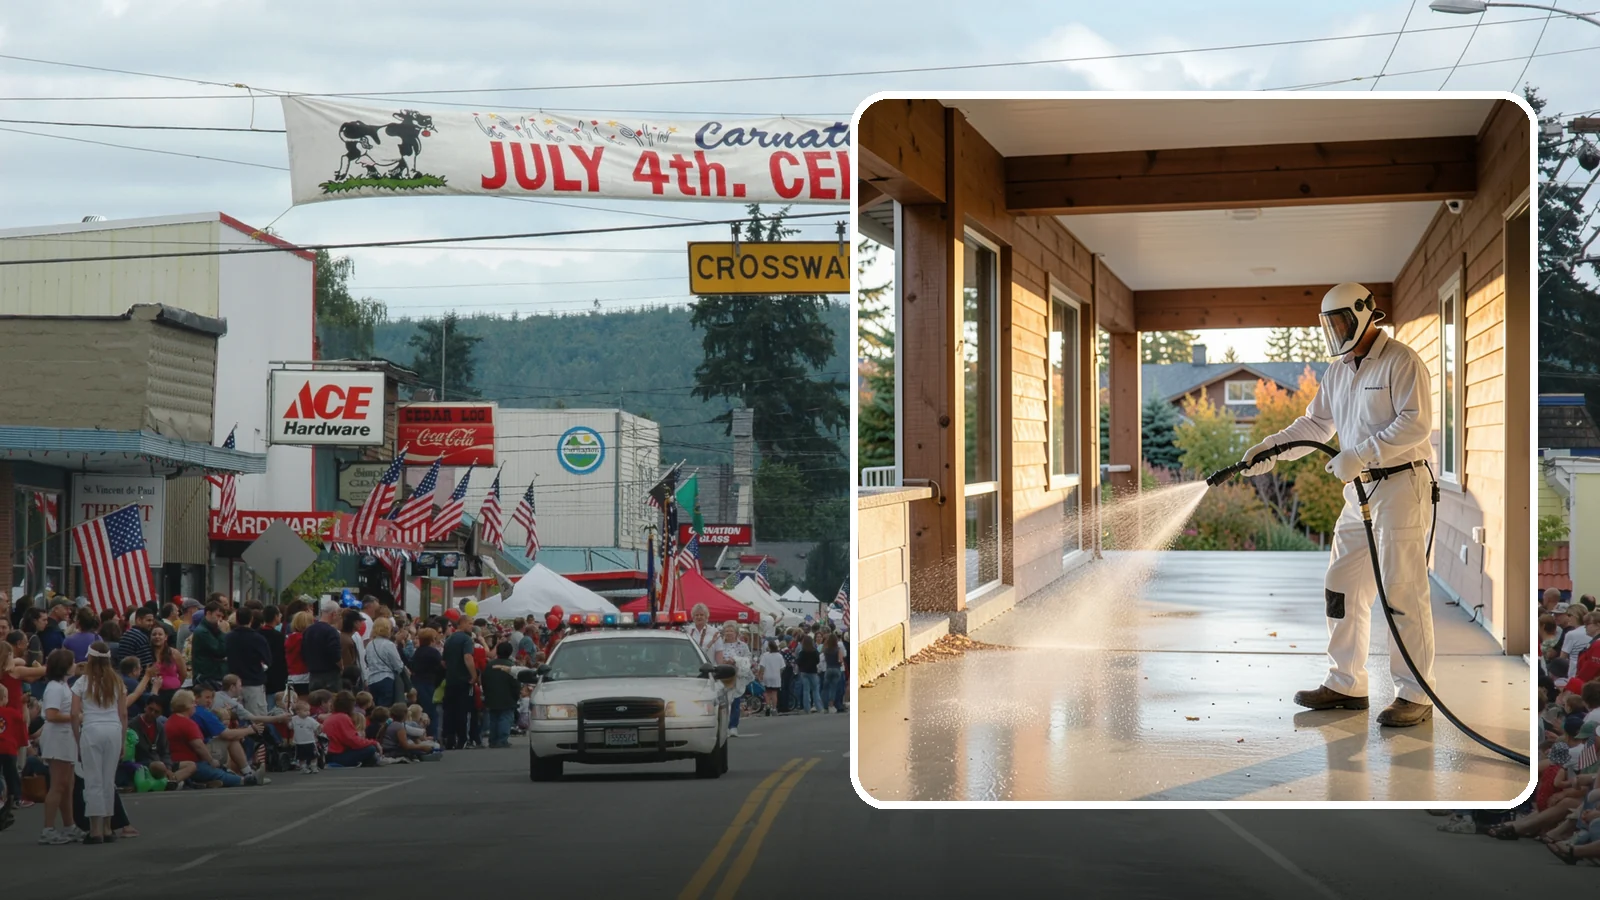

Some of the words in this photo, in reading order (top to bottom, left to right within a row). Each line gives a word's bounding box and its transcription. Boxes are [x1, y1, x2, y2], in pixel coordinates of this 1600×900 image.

[481, 141, 604, 192] JULY
[632, 149, 746, 198] 4th.
[697, 254, 850, 280] CROSSWA
[283, 380, 373, 420] ACE
[405, 409, 452, 422] CEDAR
[283, 421, 371, 436] Hardware
[353, 467, 386, 480] Simpl
[83, 485, 93, 494] St.
[96, 485, 124, 494] Vincent
[126, 486, 136, 494] de
[138, 486, 155, 495] Paul
[81, 503, 153, 521] THT
[212, 516, 330, 535] HARDARE
[688, 526, 741, 535] CRNATION
[699, 535, 730, 543] GLASS
